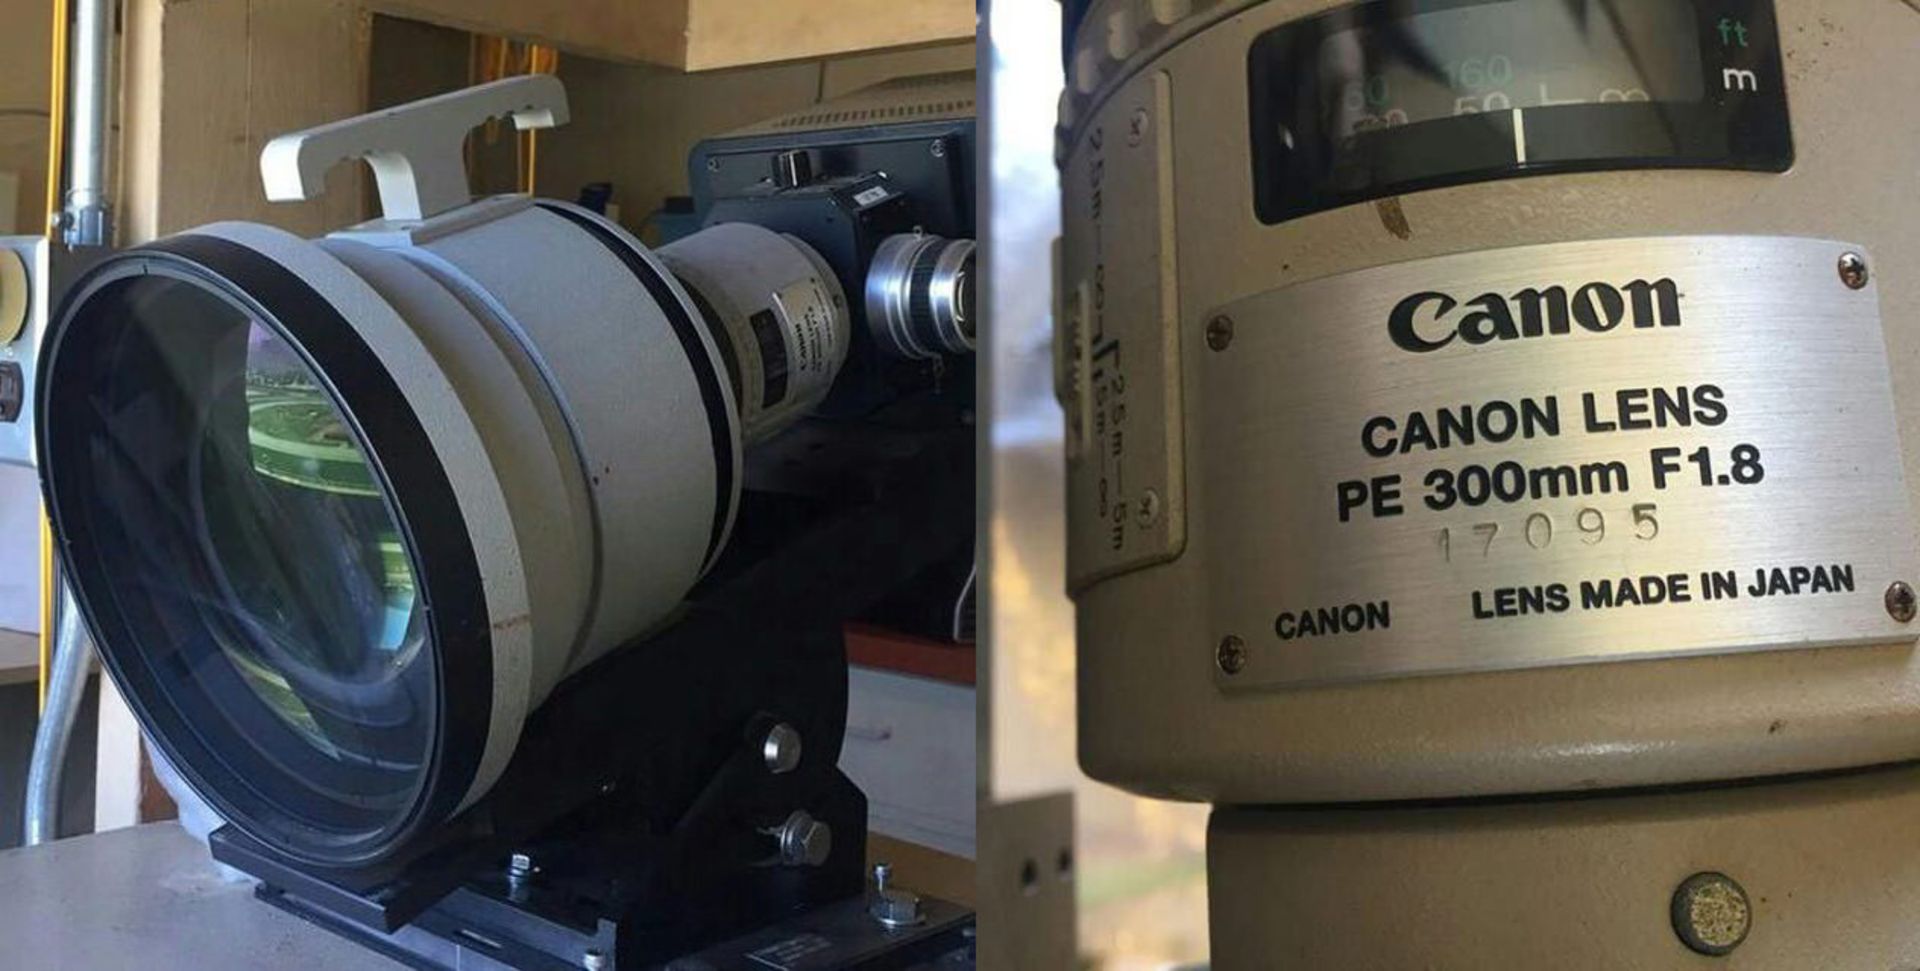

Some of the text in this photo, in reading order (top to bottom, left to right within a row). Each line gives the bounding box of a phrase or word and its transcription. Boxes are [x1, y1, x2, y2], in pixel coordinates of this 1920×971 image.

[1717, 18, 1749, 47] ft
[1722, 68, 1757, 92] m
[1386, 276, 1683, 354] Canon
[1360, 383, 1729, 458] CANON LENS
[1337, 442, 1765, 522] PE 300mm F1.8
[1437, 502, 1659, 563] 17095
[1274, 563, 1856, 641] CANON LENS MADE IN JAPAN
